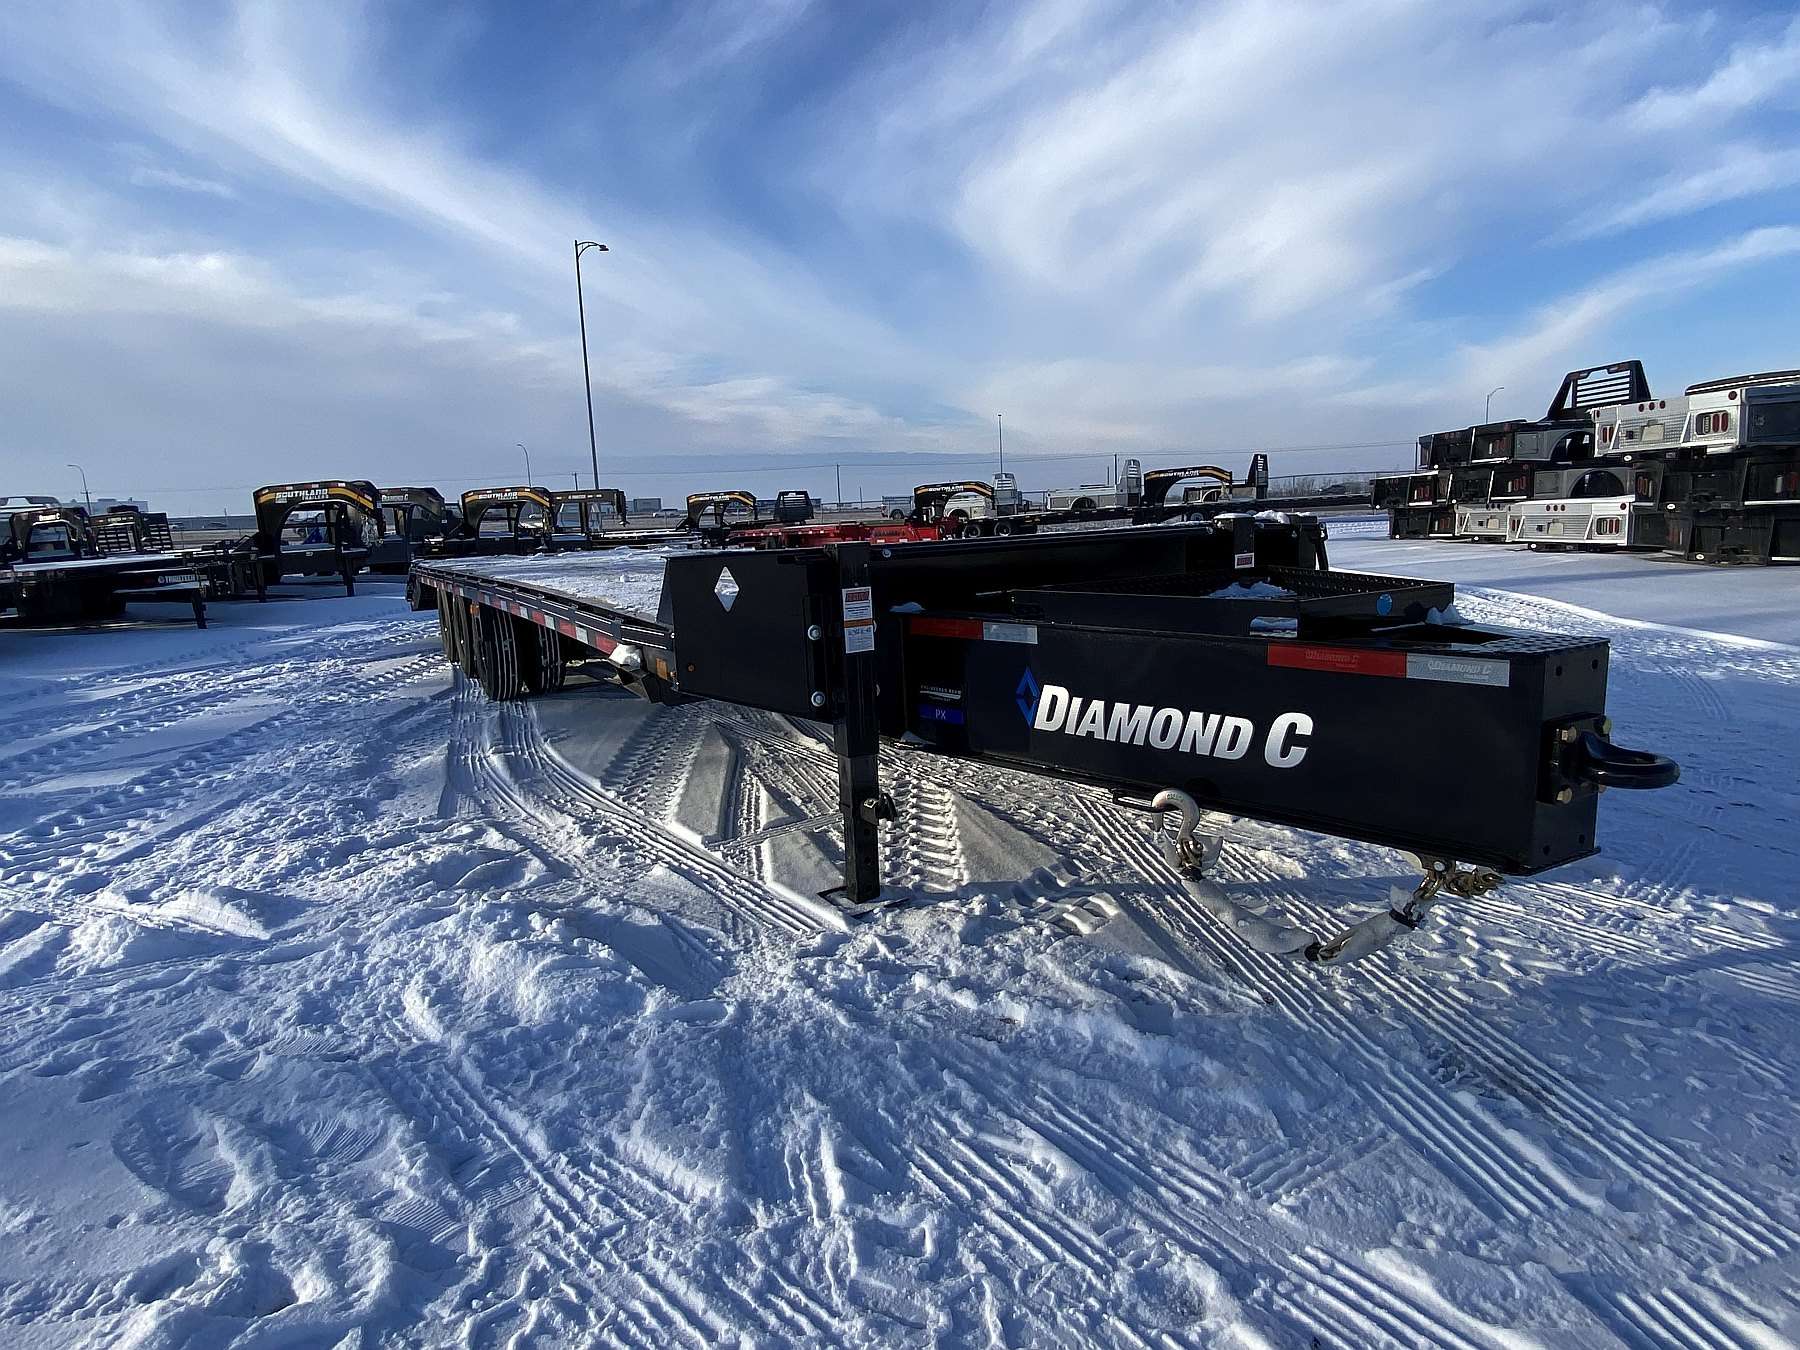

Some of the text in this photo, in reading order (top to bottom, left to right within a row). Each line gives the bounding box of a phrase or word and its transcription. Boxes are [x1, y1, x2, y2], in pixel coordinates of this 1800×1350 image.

[275, 488, 328, 499] SOUTHLAND
[1033, 684, 1314, 769] DIAMOND C
